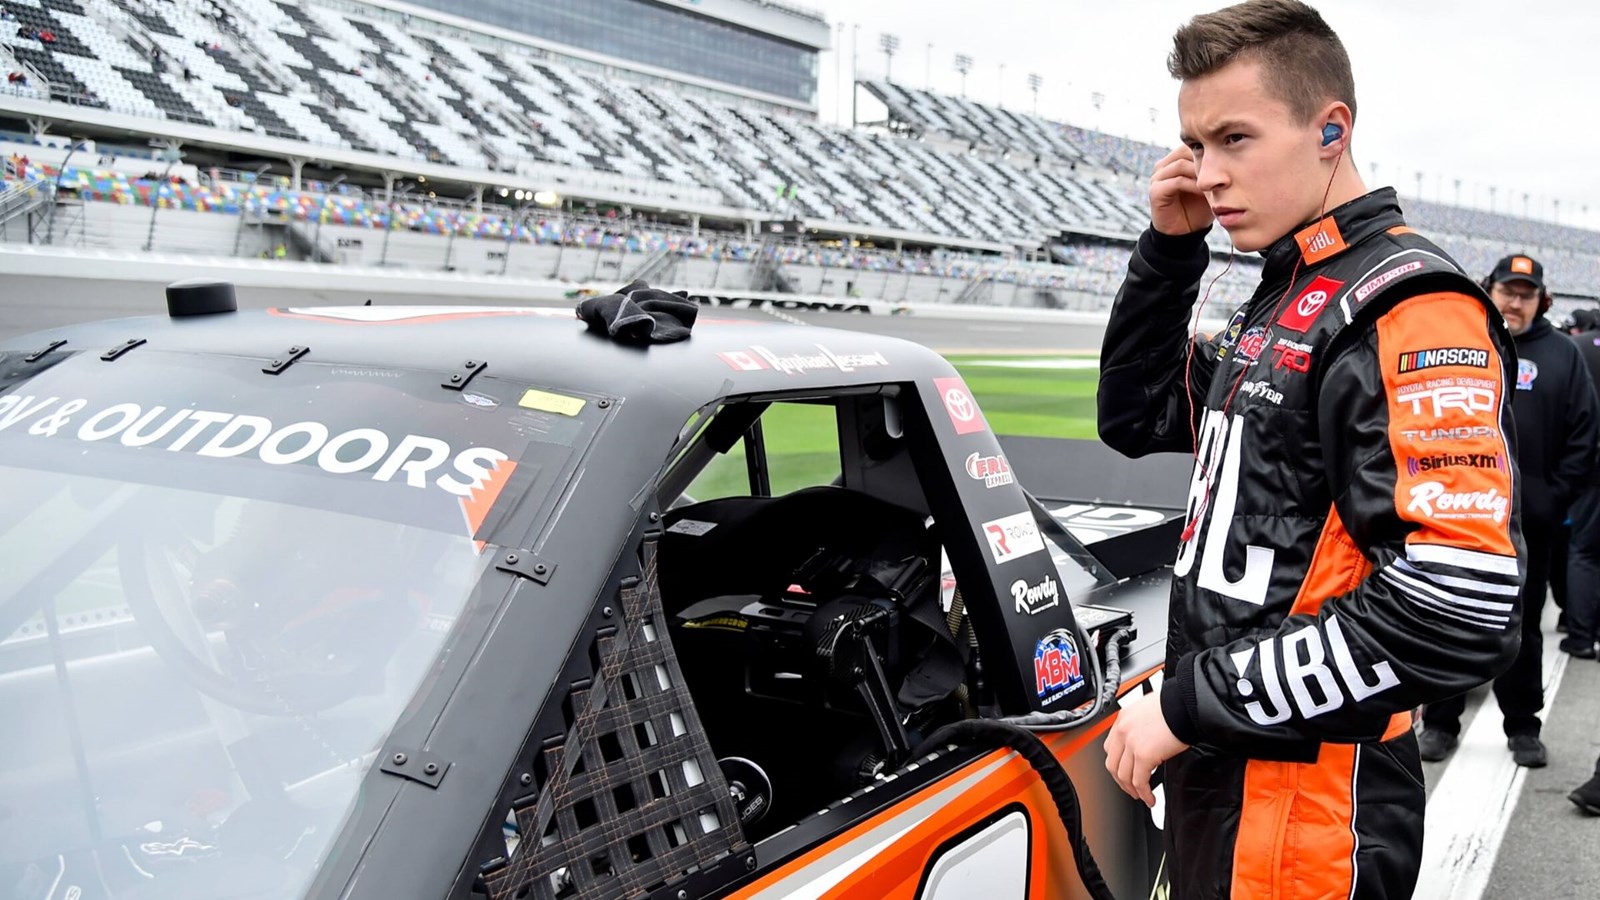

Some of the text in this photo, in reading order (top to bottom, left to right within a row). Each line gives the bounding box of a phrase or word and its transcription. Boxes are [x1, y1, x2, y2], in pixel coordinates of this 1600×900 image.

[1307, 230, 1336, 253] JBL
[1359, 263, 1416, 298] SIMPSON
[1425, 348, 1488, 367] NASCAR
[1397, 377, 1497, 394] TOYOTA RACING DEVELOPMENT
[1397, 386, 1495, 418] TRD
[28, 398, 88, 437] &
[78, 402, 508, 504] OUTDOORS
[975, 456, 1009, 478] FRL
[1174, 406, 1275, 606] BL
[1407, 481, 1508, 523] Rowdy
[1011, 575, 1059, 614] Rowdy
[1034, 648, 1081, 696] KBM
[1244, 614, 1401, 726] JBL
[741, 797, 764, 820] JOES
